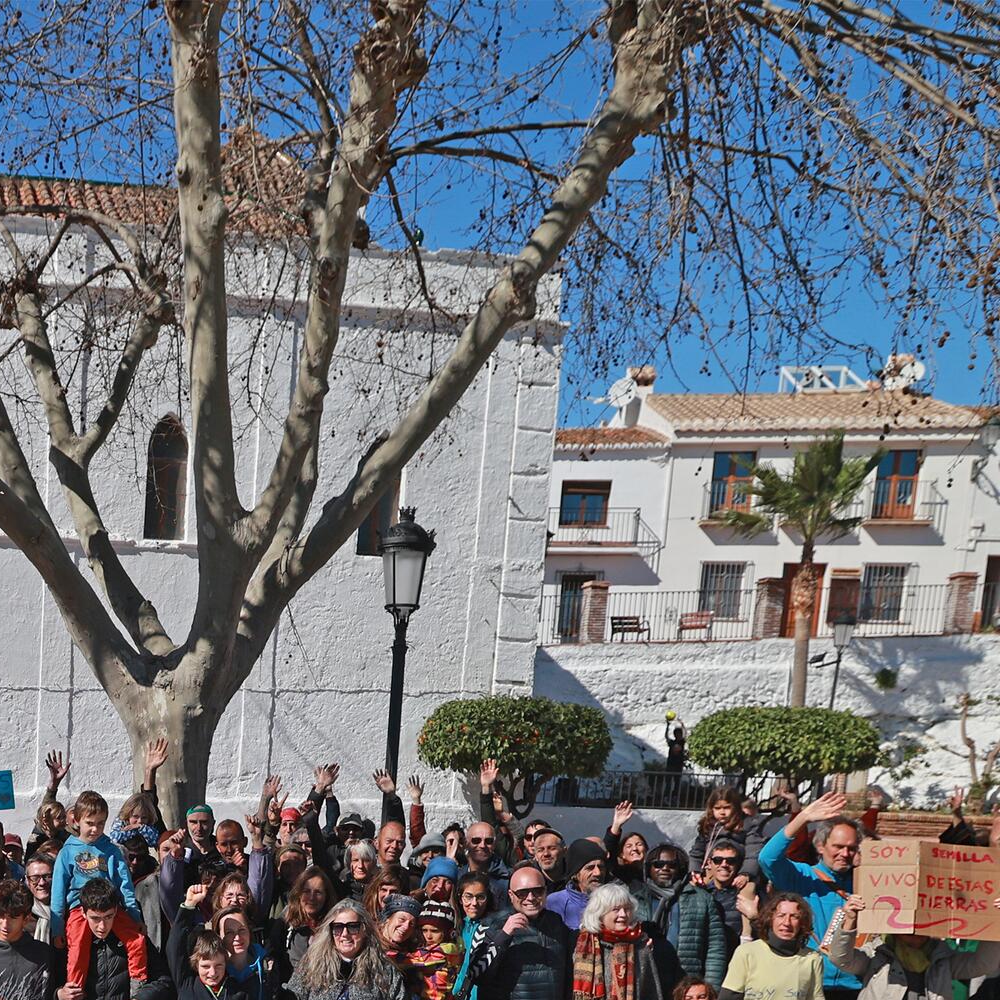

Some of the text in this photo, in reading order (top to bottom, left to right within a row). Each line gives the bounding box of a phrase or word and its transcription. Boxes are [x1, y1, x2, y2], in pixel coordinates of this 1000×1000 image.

[870, 846, 994, 863] SOY SEMILLA
[869, 873, 917, 887] VIVO
[918, 893, 988, 912] TIERRAS
